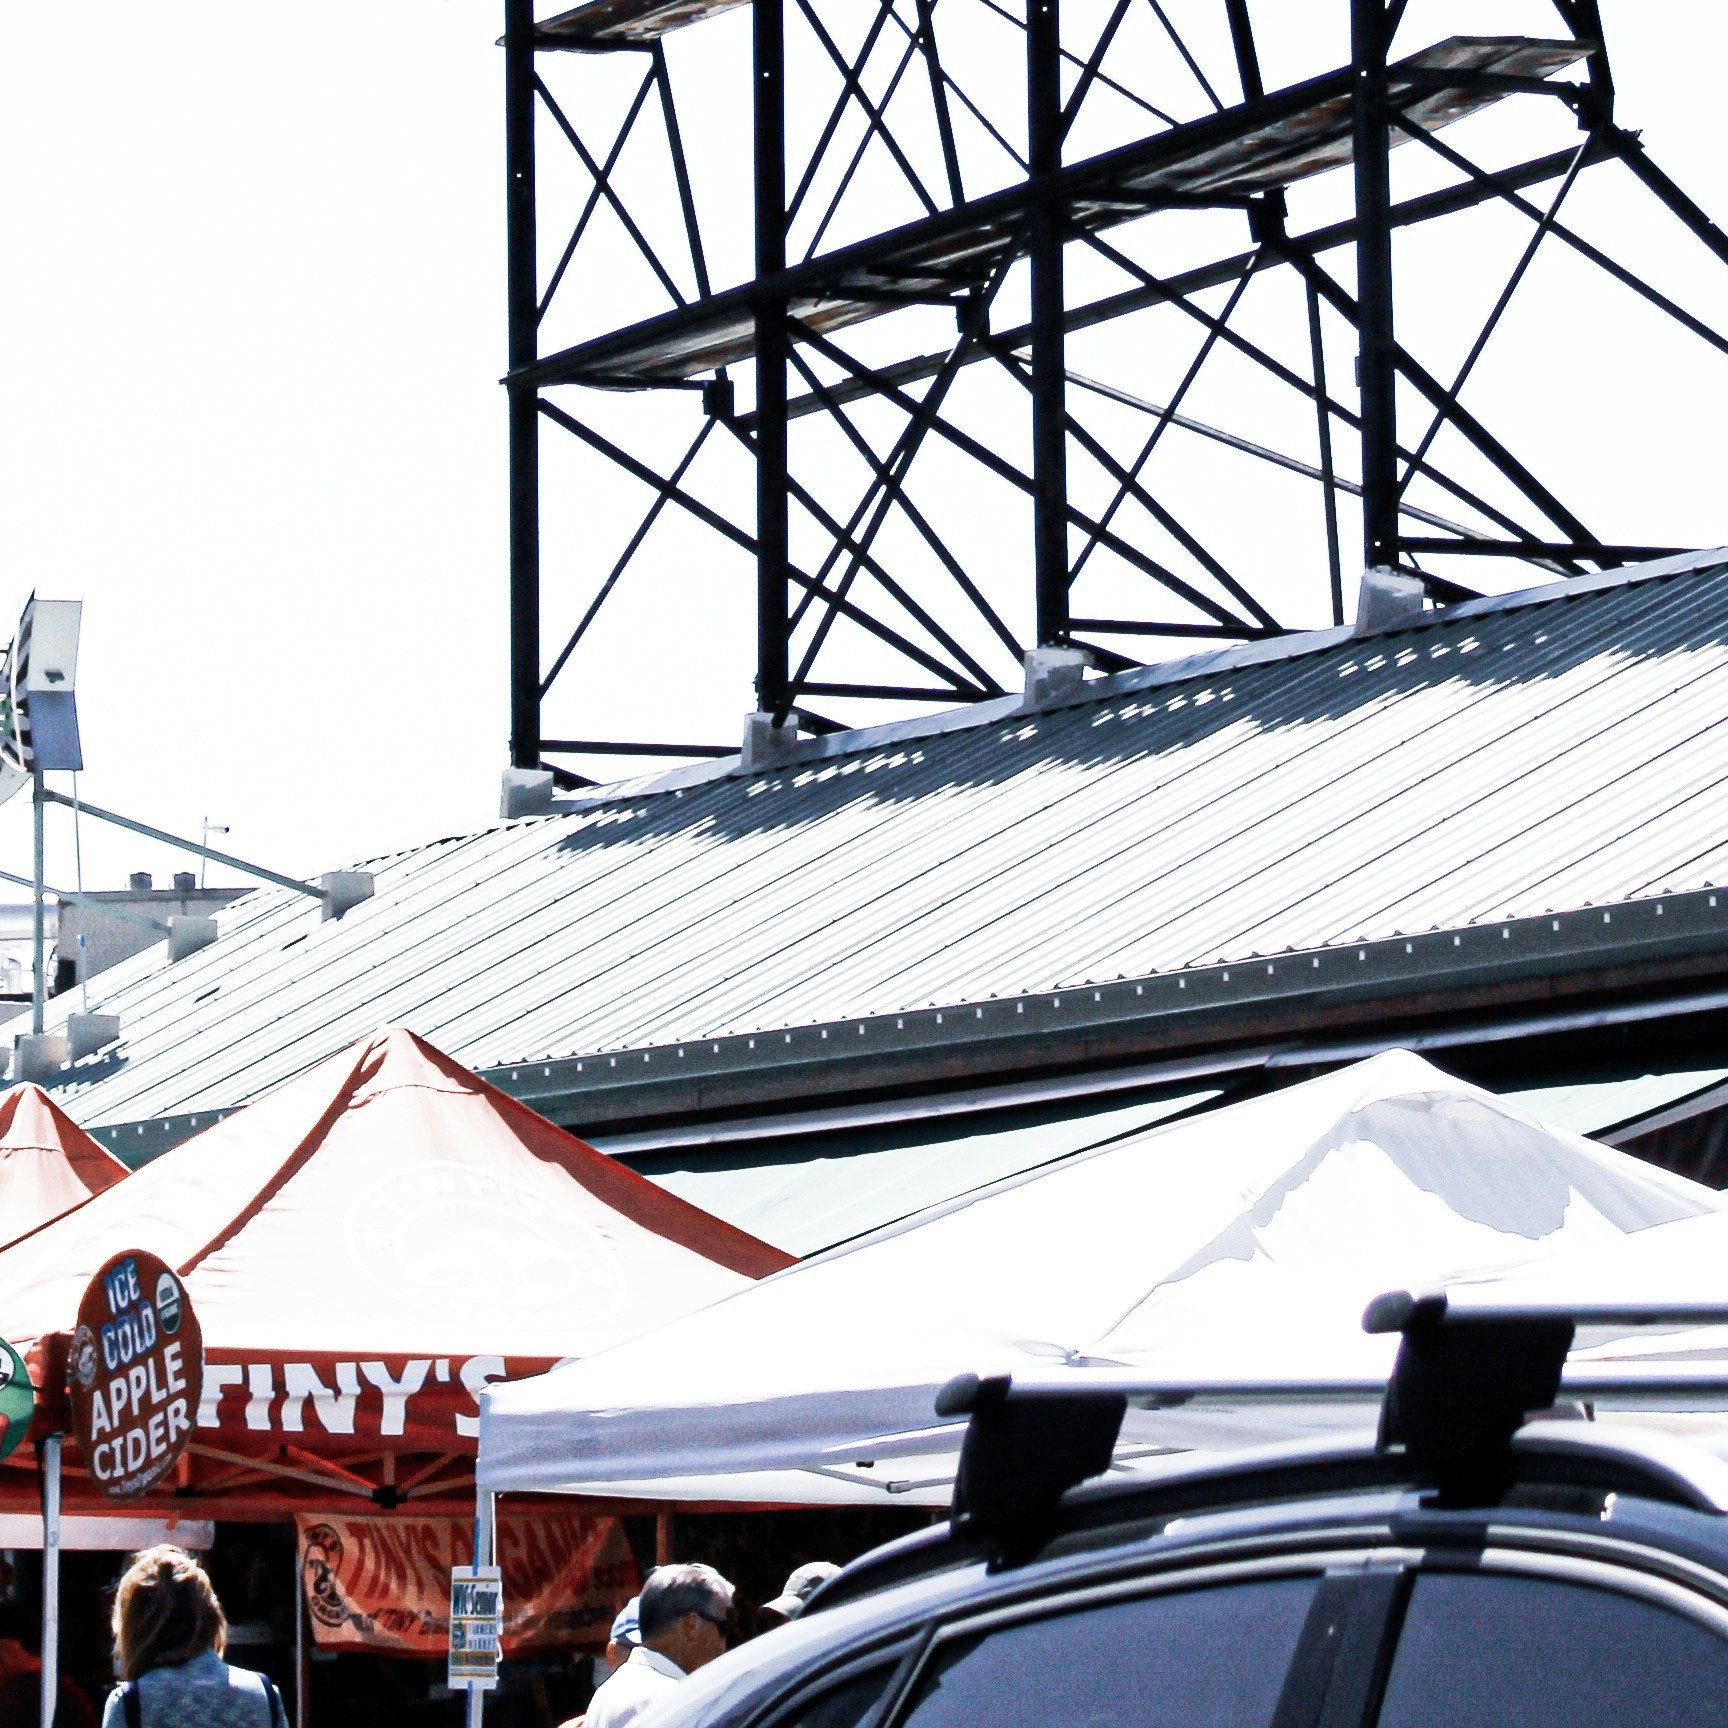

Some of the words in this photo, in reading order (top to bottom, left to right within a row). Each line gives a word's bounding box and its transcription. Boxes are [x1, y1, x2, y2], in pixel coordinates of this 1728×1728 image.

[106, 1257, 141, 1314] ICE
[101, 1299, 156, 1371] COLD
[91, 1341, 187, 1441] APPLE
[197, 1355, 507, 1437] TINY'S
[93, 1398, 191, 1480] CIDER
